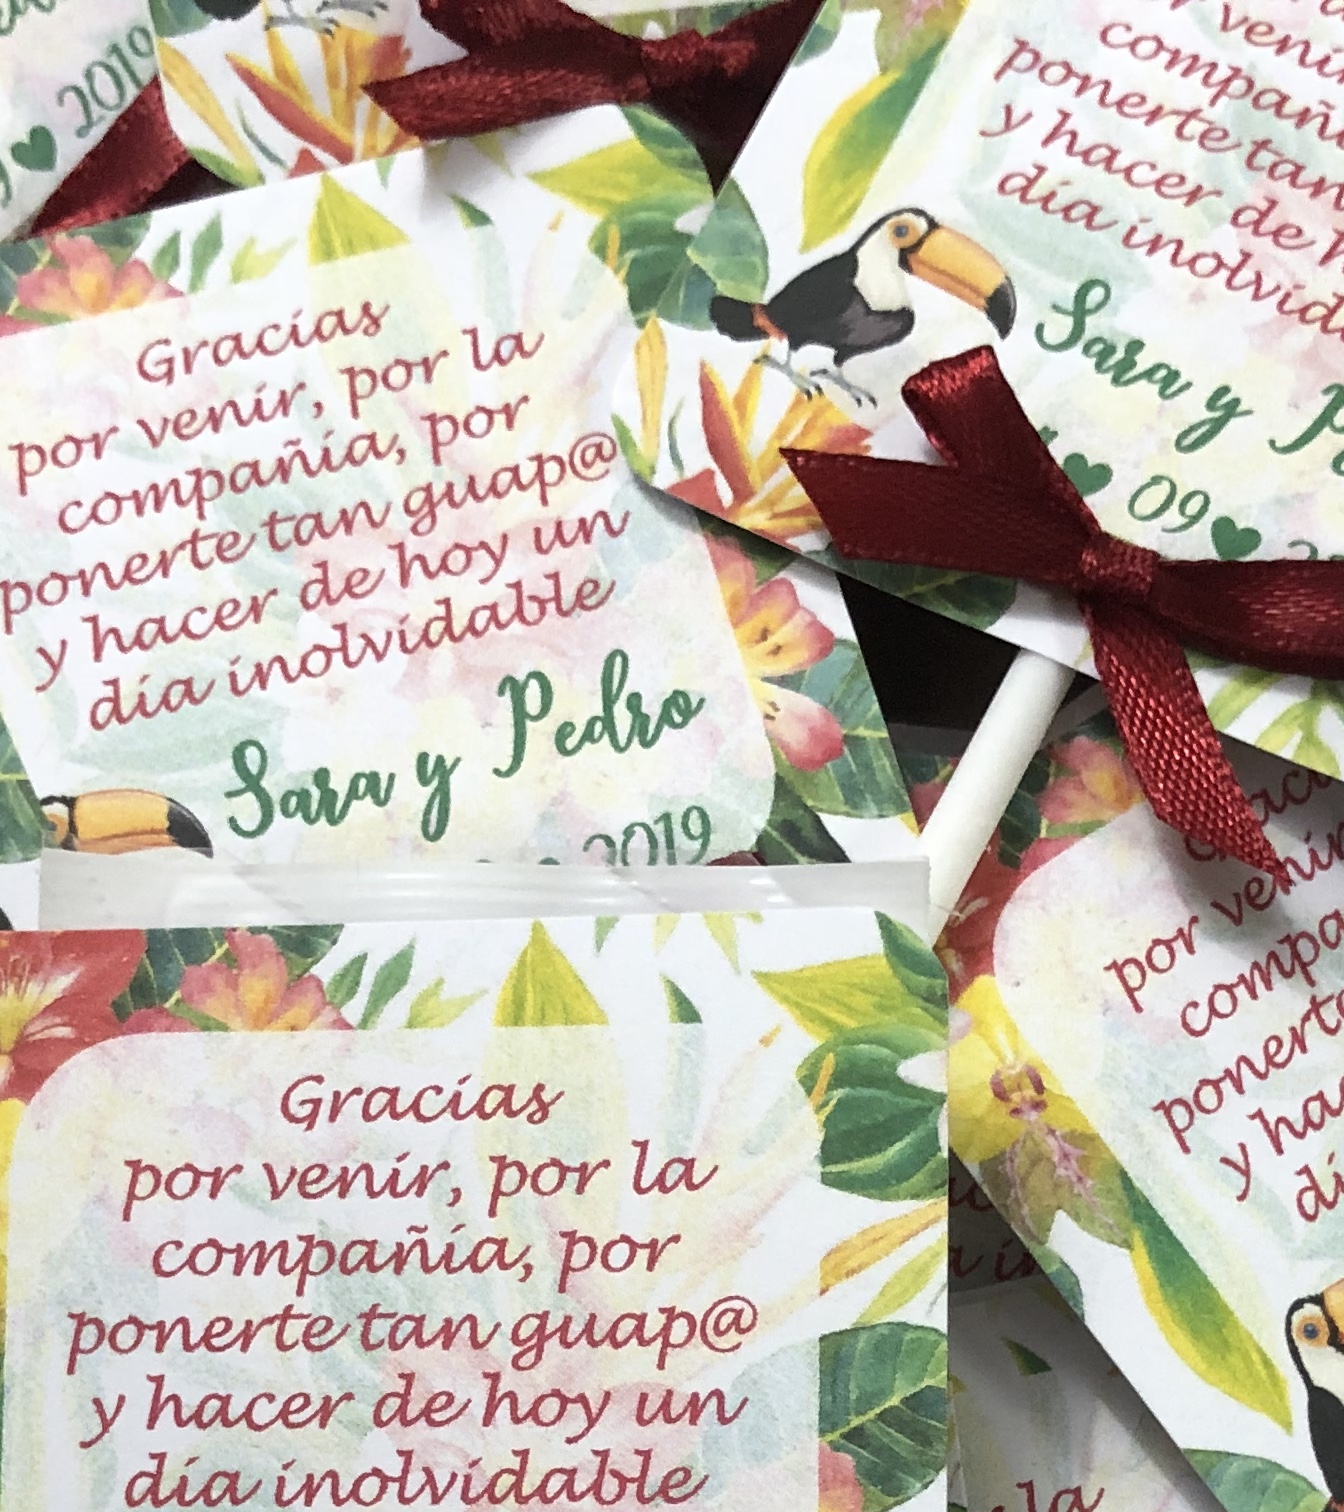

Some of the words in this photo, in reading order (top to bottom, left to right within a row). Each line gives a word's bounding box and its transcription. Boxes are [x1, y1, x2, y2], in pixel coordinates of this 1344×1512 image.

[994, 38, 1241, 152] ponerte
[136, 301, 390, 385] Gracias
[1035, 279, 1193, 402] Sara
[1175, 385, 1254, 456] y
[8, 426, 119, 497] por
[136, 382, 323, 448] venir,
[339, 350, 449, 420] por
[462, 327, 544, 371] la
[420, 395, 530, 466] por
[262, 500, 390, 552] tan
[403, 432, 617, 536] guap@
[1129, 474, 1210, 531] 09
[224, 739, 394, 837] Sara
[416, 752, 458, 842] y
[495, 651, 704, 777] Pedro
[1103, 915, 1200, 1014] por
[280, 1074, 565, 1132] Gracias
[122, 1159, 243, 1222] por
[262, 1152, 462, 1207] venir,
[488, 1154, 611, 1218] por
[632, 1140, 719, 1195] la
[1220, 1143, 1251, 1202] y
[558, 1230, 681, 1294] por
[67, 1304, 351, 1375] ponerte
[358, 1303, 501, 1352] tan
[509, 1295, 758, 1371] guap@
[79, 1394, 126, 1449] y
[146, 1374, 355, 1432] hacer
[373, 1371, 472, 1428] de
[482, 1371, 612, 1445] hoy
[635, 1388, 748, 1427] un
[275, 1448, 708, 1508] inolvidable
